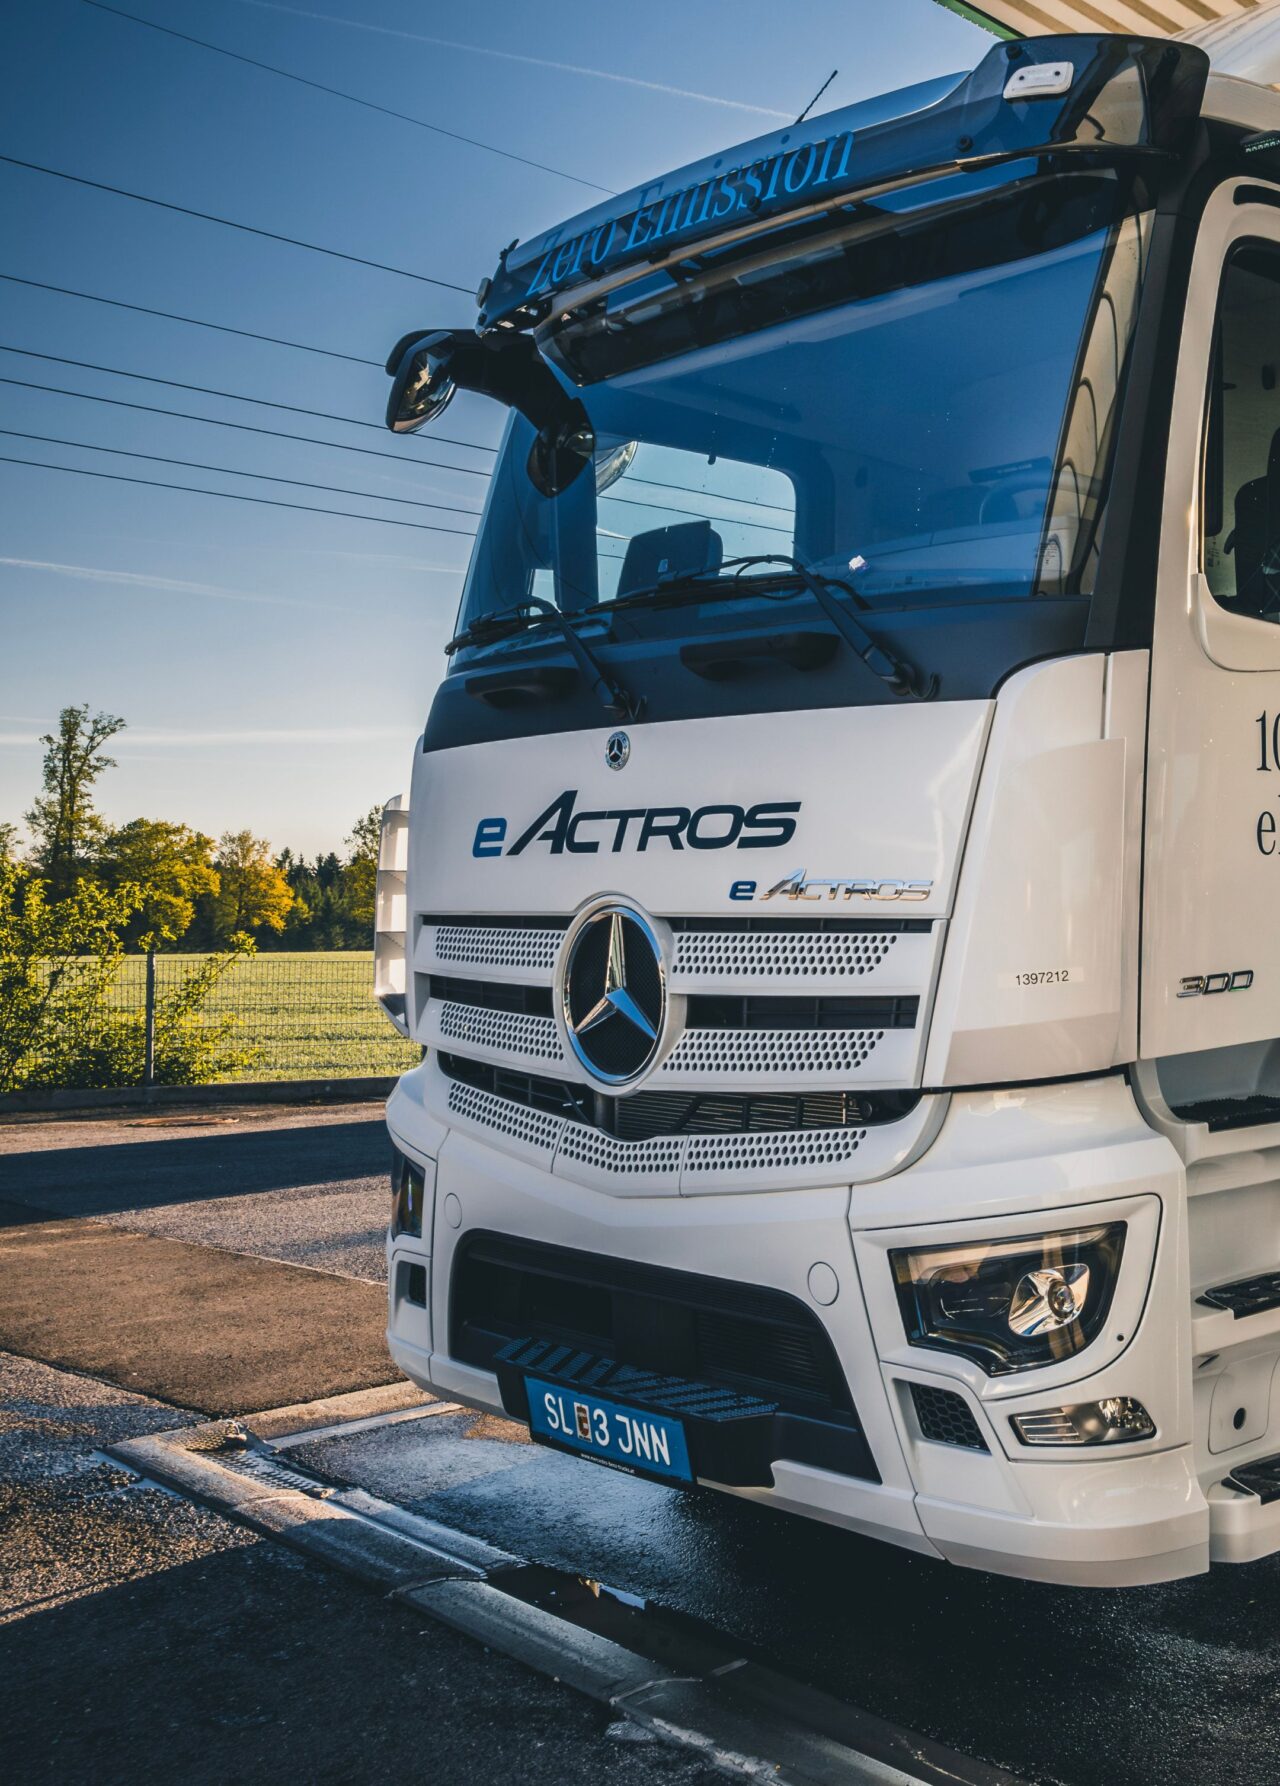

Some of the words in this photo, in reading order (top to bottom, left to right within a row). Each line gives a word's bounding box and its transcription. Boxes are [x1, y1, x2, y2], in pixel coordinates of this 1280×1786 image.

[526, 217, 616, 297] Zero
[621, 130, 856, 253] Emission
[1015, 970, 1069, 986] 1397212
[1176, 970, 1254, 998] 300
[544, 1392, 574, 1436] SL
[593, 1408, 610, 1447] 3
[615, 1413, 671, 1466] JNN
